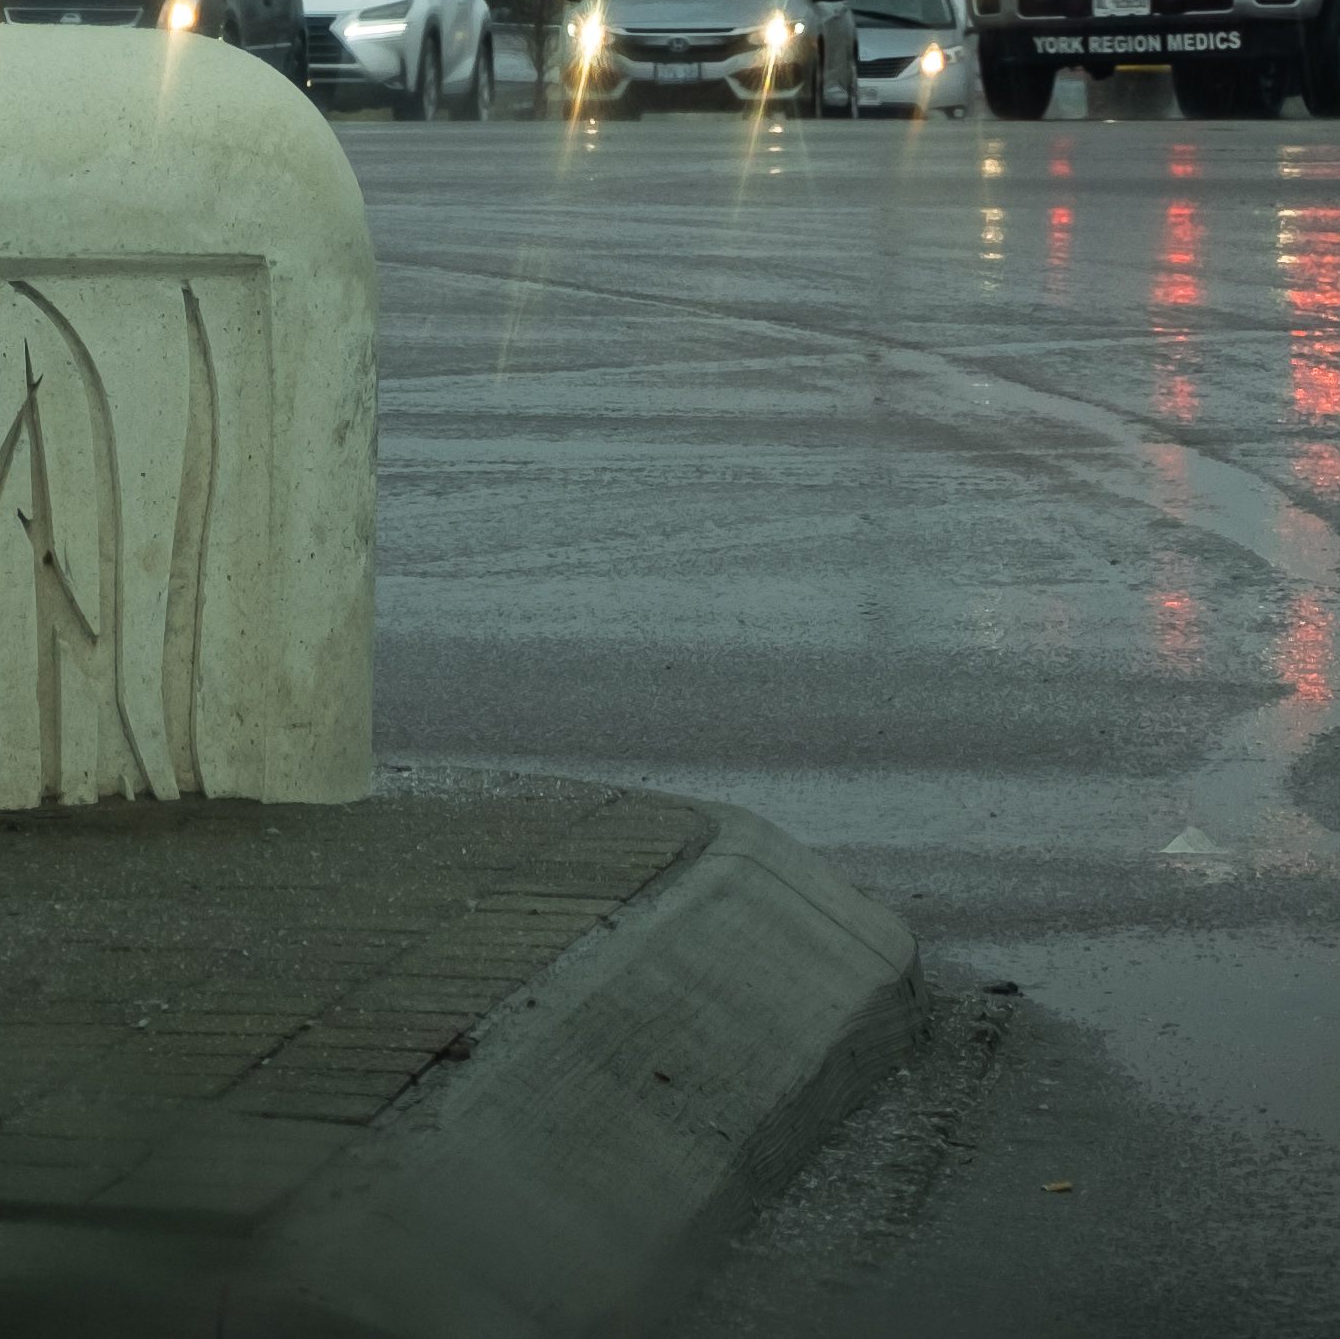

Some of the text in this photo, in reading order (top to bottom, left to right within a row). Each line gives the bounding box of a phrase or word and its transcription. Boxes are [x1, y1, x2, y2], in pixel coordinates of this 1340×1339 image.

[1032, 31, 1242, 54] YORK REGION MEDICS
